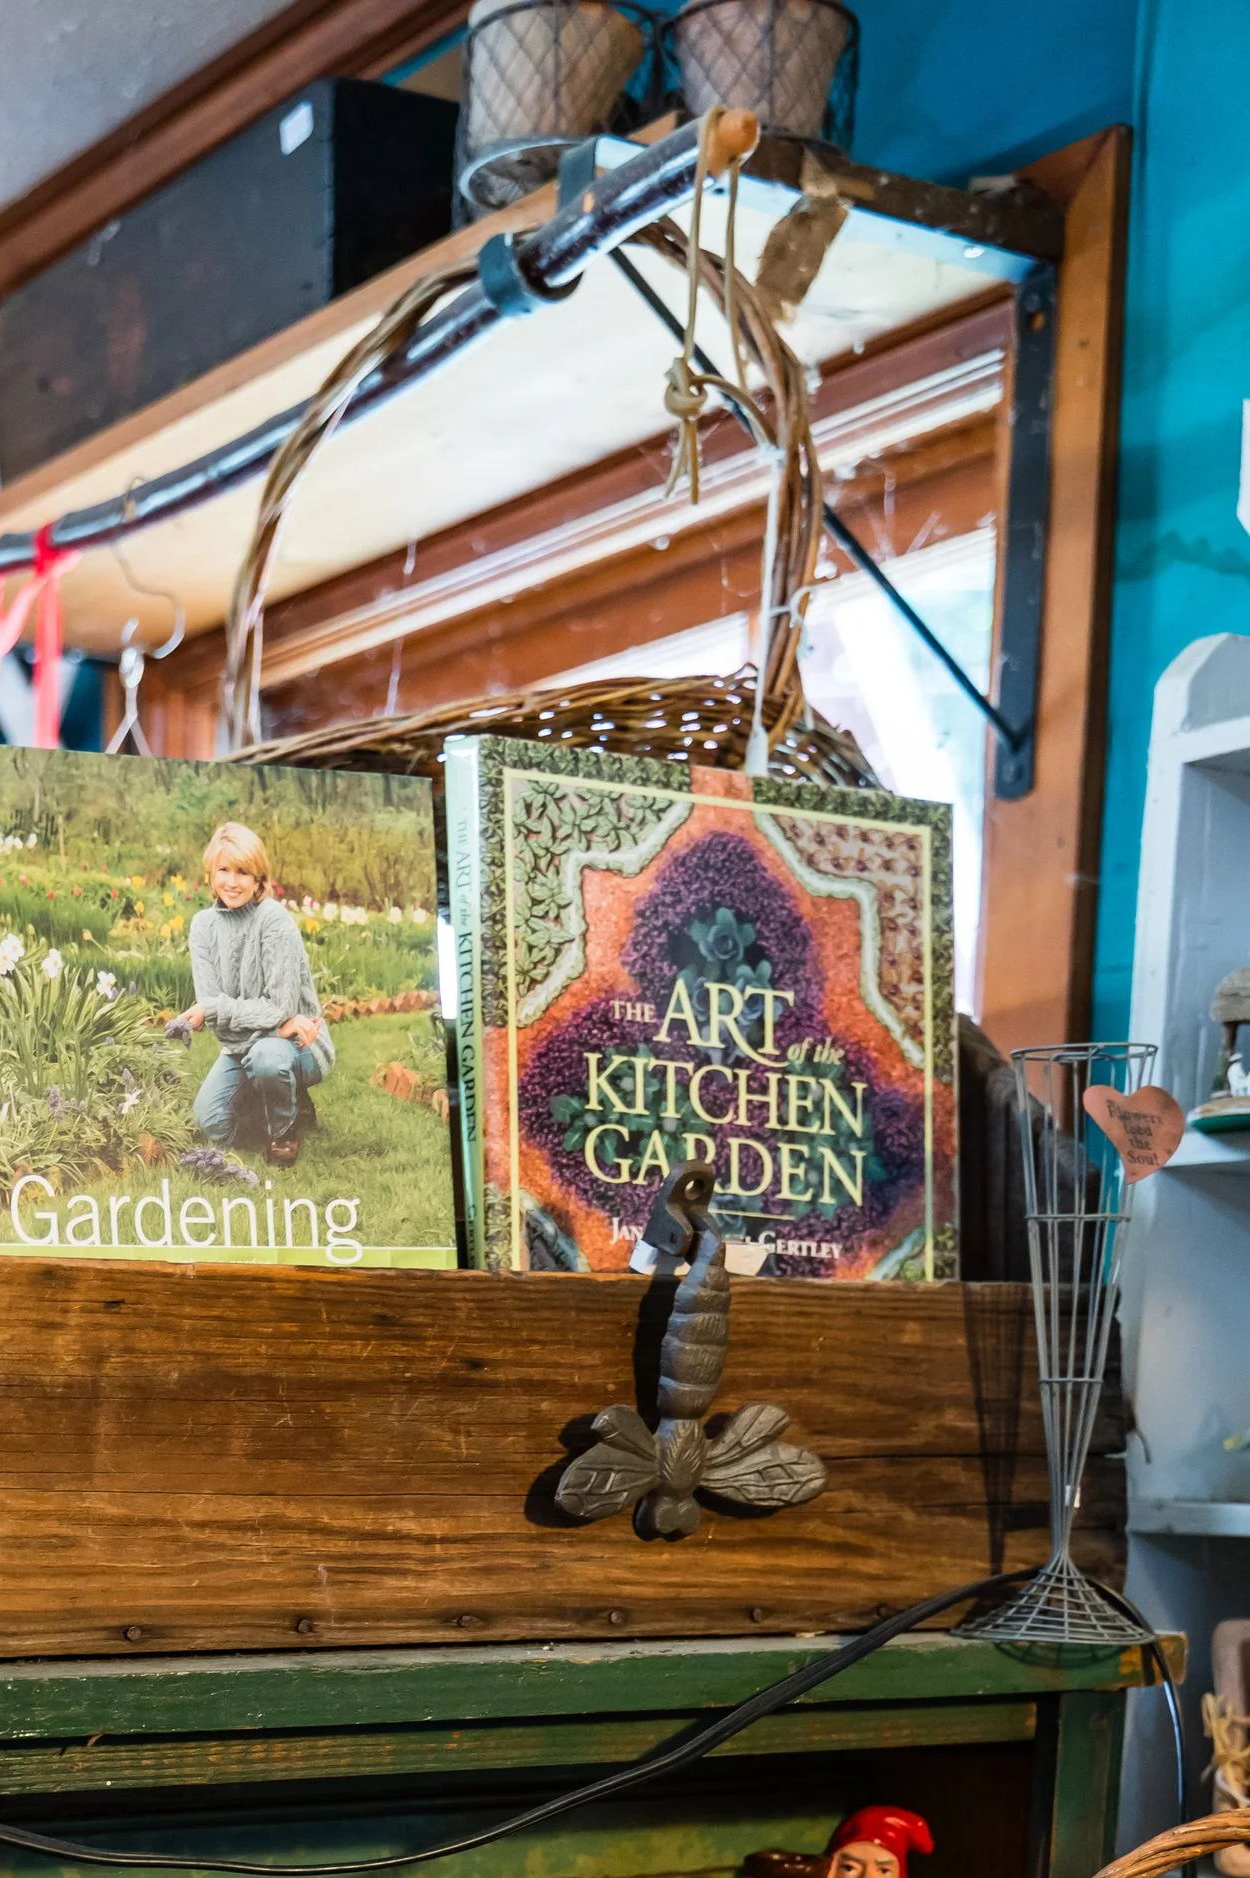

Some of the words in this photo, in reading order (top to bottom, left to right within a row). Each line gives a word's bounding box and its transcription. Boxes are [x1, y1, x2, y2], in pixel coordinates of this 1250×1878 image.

[456, 850, 471, 889] ART
[458, 931, 474, 1038] KITCHEN
[611, 1000, 657, 1023] THE
[653, 978, 794, 1068] ART
[787, 1037, 814, 1064] of
[814, 1037, 845, 1065] the
[461, 1044, 477, 1142] GARDEN
[584, 1052, 868, 1138] KITCHEN
[10, 1175, 363, 1264] Gardening
